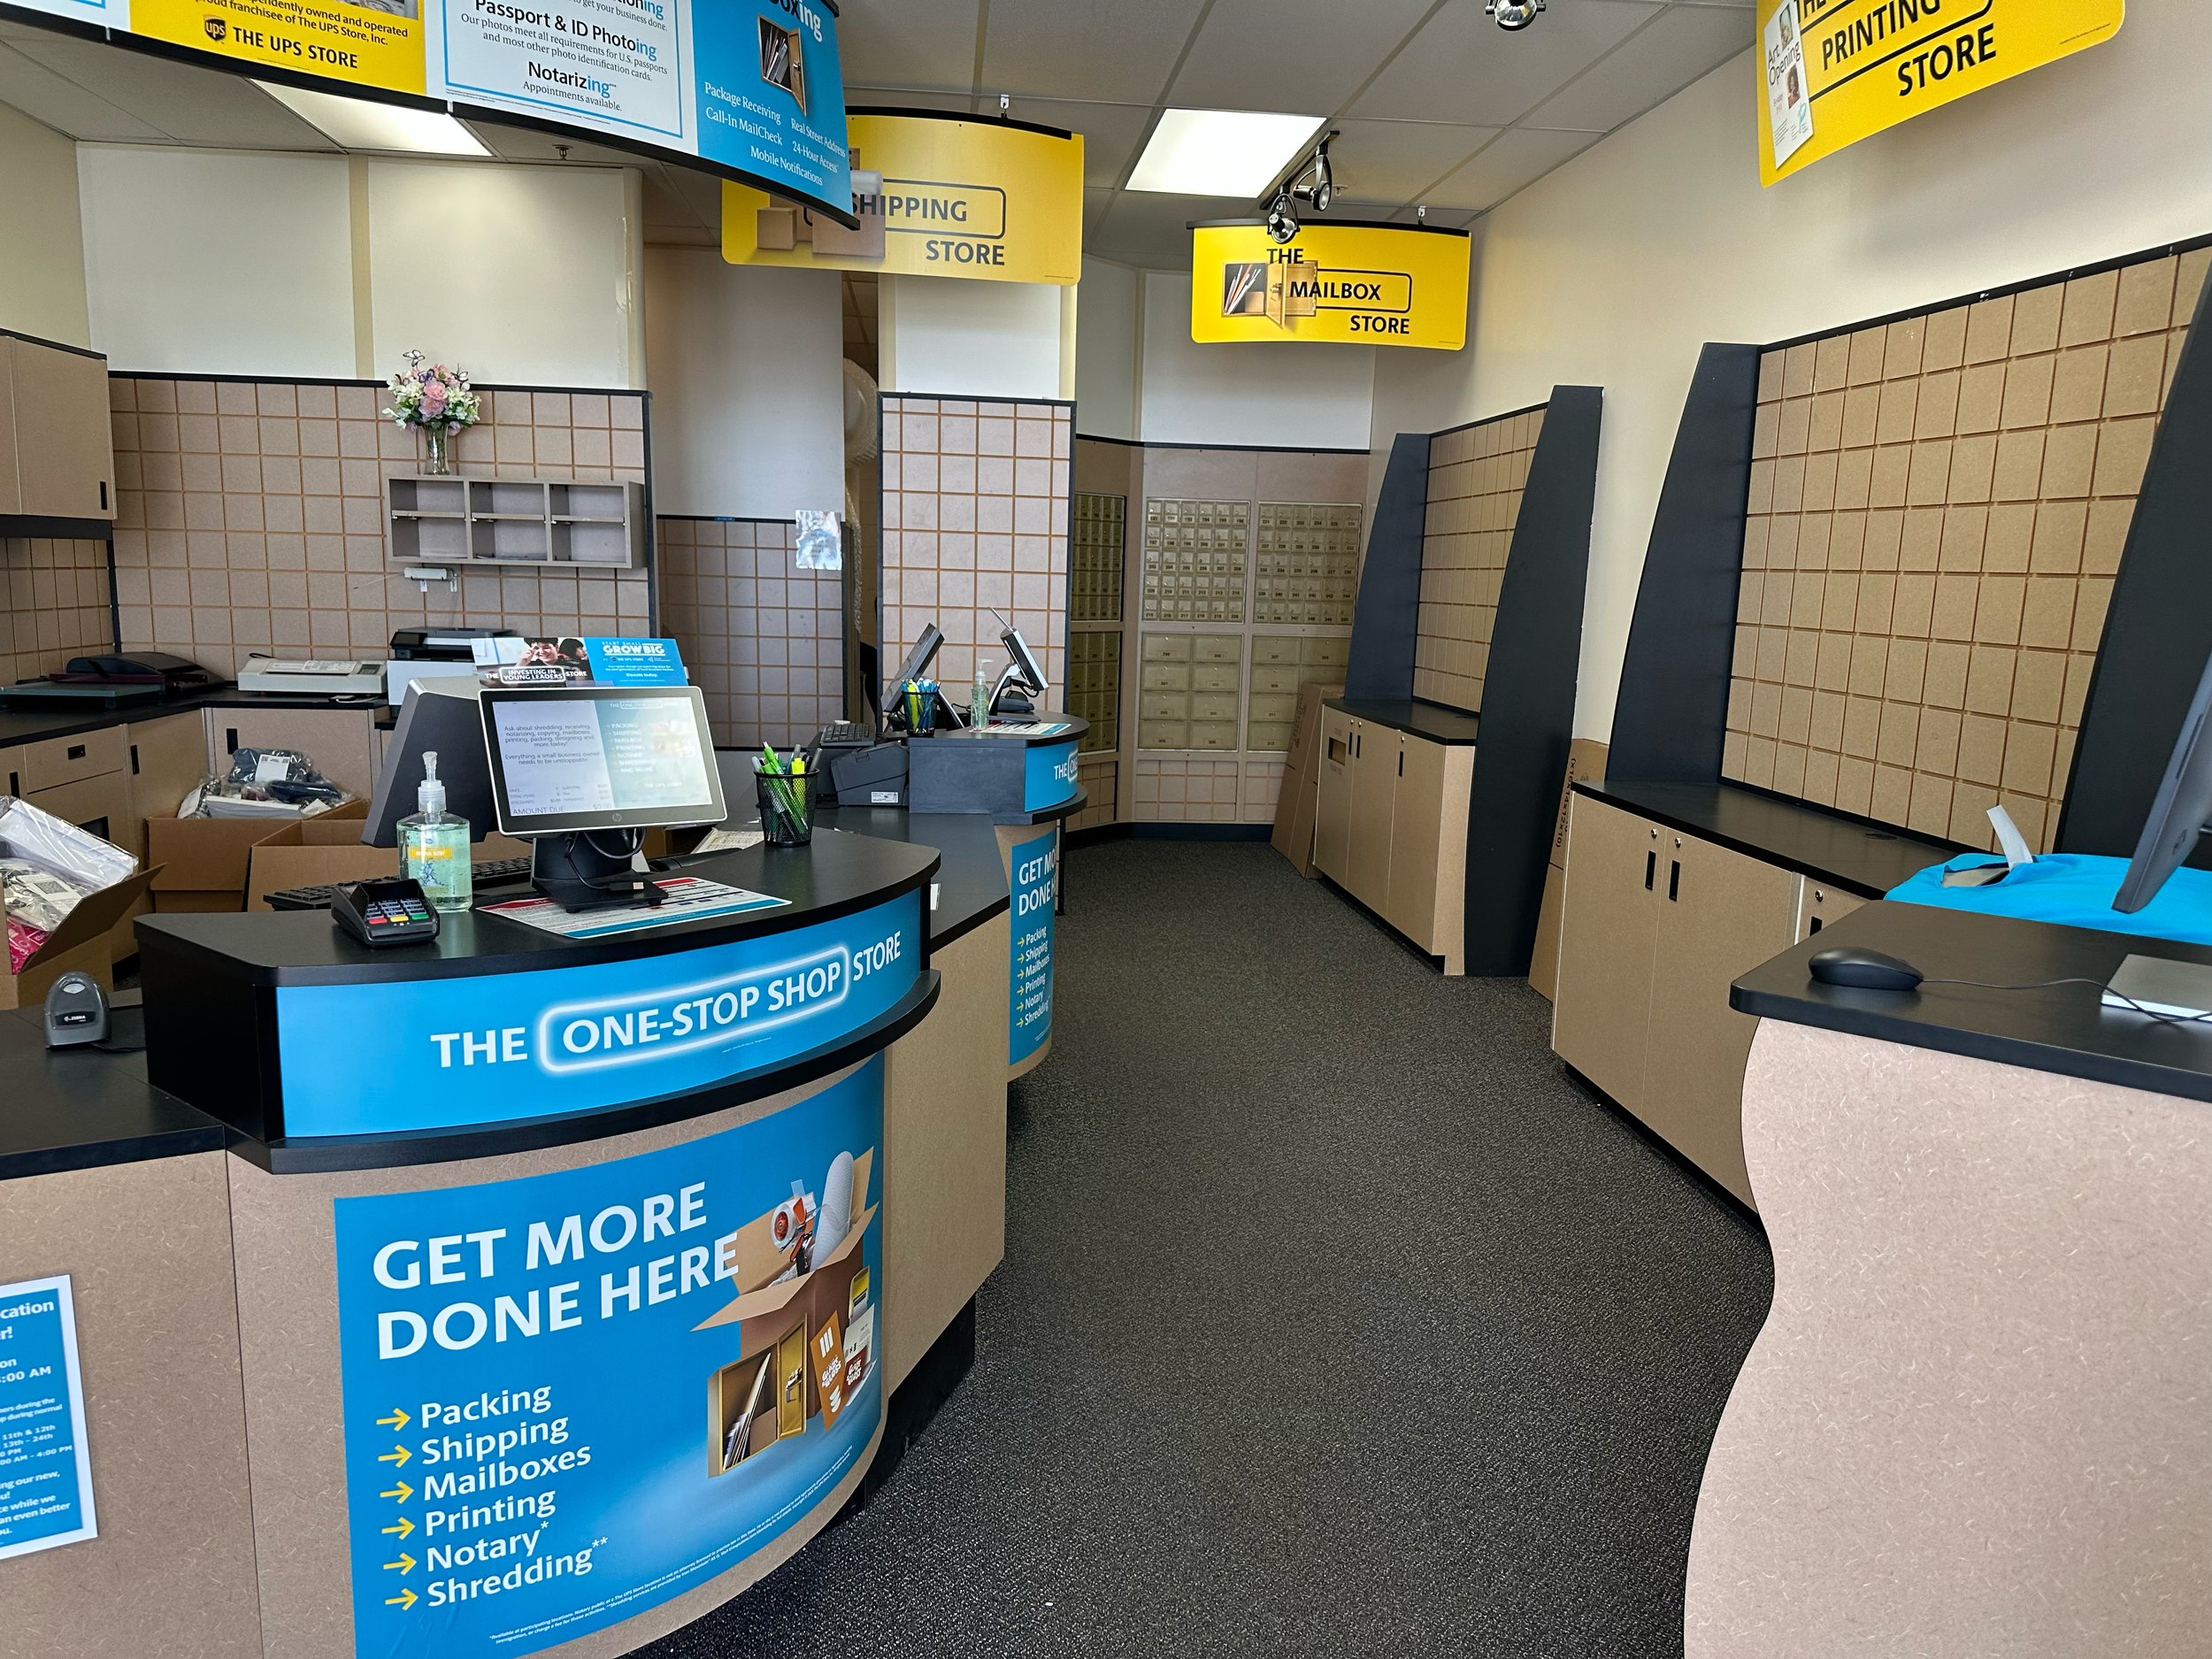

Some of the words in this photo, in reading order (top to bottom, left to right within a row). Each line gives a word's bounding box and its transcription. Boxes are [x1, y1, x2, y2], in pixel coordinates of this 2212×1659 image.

[230, 1, 282, 21] franchisee
[285, 15, 296, 24] of
[297, 16, 317, 29] The
[319, 21, 339, 34] UPS
[341, 27, 369, 42] Store,
[372, 33, 388, 45] Inc.
[306, 7, 341, 22] owned
[342, 16, 362, 27] and
[364, 21, 408, 37] operated
[475, 0, 550, 27] Passport
[555, 15, 567, 32] &
[572, 19, 588, 36] ID
[593, 25, 657, 61] Photoing
[596, 3, 614, 13] your
[616, 6, 647, 24] business
[648, 18, 667, 31] done.
[233, 27, 264, 48] THE
[270, 35, 302, 56] UPS
[308, 44, 357, 68] STORE
[461, 13, 480, 25] Our
[481, 18, 513, 33] photos
[515, 27, 536, 38] meet
[538, 32, 549, 42] all
[550, 35, 605, 56] requirements
[606, 49, 618, 59] for
[619, 52, 633, 65] U.S.
[634, 58, 668, 74] passports
[483, 32, 501, 42] and
[503, 36, 525, 48] most
[526, 42, 549, 54] other
[551, 47, 576, 61] photo
[578, 54, 631, 75] identification
[631, 70, 653, 81] cards.
[1768, 45, 1780, 70] Art
[1769, 41, 1801, 86] Opening
[1898, 22, 1997, 96] STORE
[522, 81, 585, 103] Appointments
[585, 94, 623, 111] available.
[704, 81, 741, 107] Package
[742, 96, 781, 126] Receiving
[705, 106, 737, 128] Call-In
[739, 118, 783, 146] MailCheck
[791, 118, 805, 133] Real
[806, 124, 824, 146] Street
[792, 140, 819, 163] 24-Hour
[750, 145, 780, 167] Mobile
[780, 156, 824, 187] Notifications
[926, 240, 1005, 266] STORE
[1266, 248, 1304, 265] THE
[1289, 281, 1381, 301] MAILBOX
[1350, 315, 1410, 334] STORE
[603, 645, 641, 654] GROW
[643, 645, 664, 654] BIG
[1054, 762, 1067, 780] THE
[513, 806, 548, 815] AMOUNT
[1018, 856, 1043, 885] GET
[1018, 879, 1050, 916] DONE
[1025, 926, 1047, 946] Packing
[1025, 940, 1048, 962] Shipping
[1025, 954, 1050, 978] Mailboxes
[1025, 972, 1046, 994] Printing
[430, 1027, 528, 1068] THE
[563, 987, 760, 1054] ONE-STOP
[766, 961, 841, 1012] SHOP
[853, 930, 902, 982] STORE
[373, 1228, 506, 1290] GET
[526, 1181, 707, 1271] MORE
[378, 1280, 583, 1360] DONE
[601, 1232, 740, 1319] HERE
[0, 1301, 55, 1319] cation
[29, 1365, 51, 1378] AM
[7, 1410, 35, 1420] during
[34, 1403, 63, 1415] normal
[15, 1400, 42, 1410] during
[421, 1385, 552, 1429] Packing
[2, 1431, 24, 1440] 11th
[35, 1425, 56, 1433] 12th
[3, 1440, 24, 1448] 13th
[32, 1433, 53, 1442] 24th
[421, 1417, 569, 1465] Shipping
[13, 1454, 28, 1463] AM
[36, 1448, 58, 1457] 4:00
[58, 1444, 73, 1453] PM
[15, 1476, 35, 1486] our
[35, 1471, 61, 1481] new,
[424, 1446, 591, 1502] Mailboxes
[10, 1498, 40, 1510] while
[40, 1494, 56, 1503] we
[13, 1509, 39, 1521] even
[39, 1502, 71, 1515] better
[425, 1489, 557, 1537] Printing
